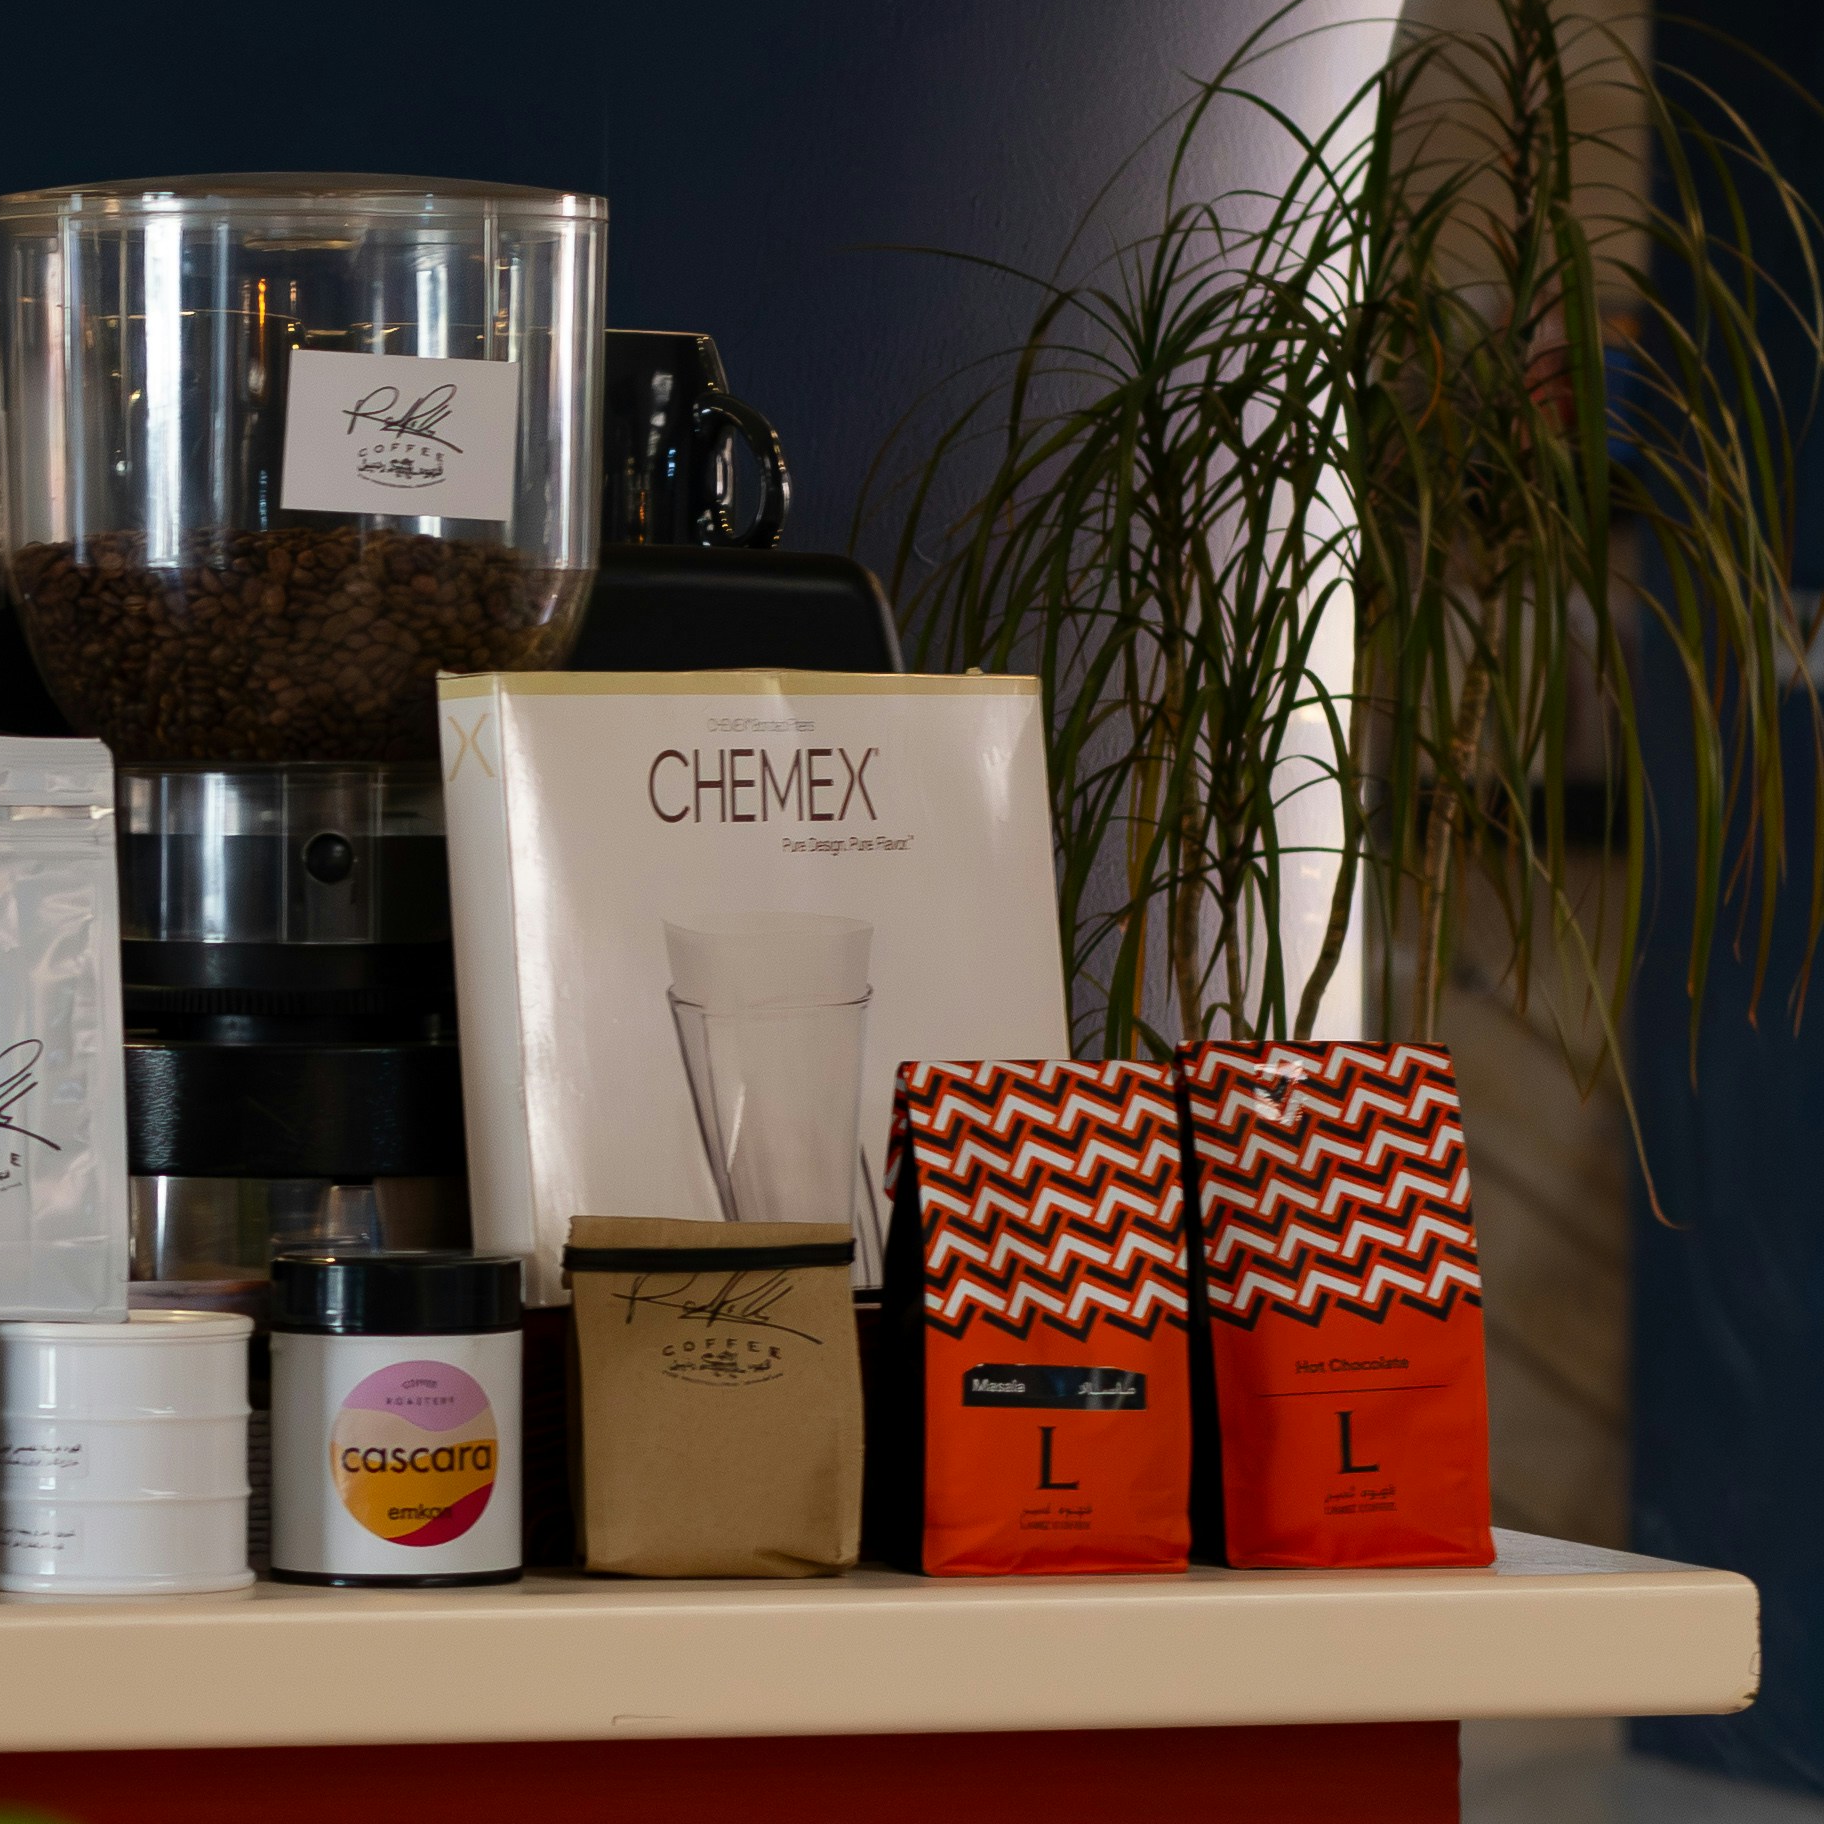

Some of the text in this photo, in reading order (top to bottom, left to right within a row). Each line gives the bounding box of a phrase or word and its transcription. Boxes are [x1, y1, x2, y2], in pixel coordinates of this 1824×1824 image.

[358, 442, 444, 462] COFFEE
[649, 747, 880, 823] CHEMEX
[662, 1338, 782, 1360] COFFEE
[1296, 1357, 1409, 1373] Hot Chocolate
[972, 1379, 1026, 1393] Masala
[1334, 1410, 1380, 1474] L
[342, 1446, 491, 1473] cascara
[1038, 1426, 1080, 1490] L
